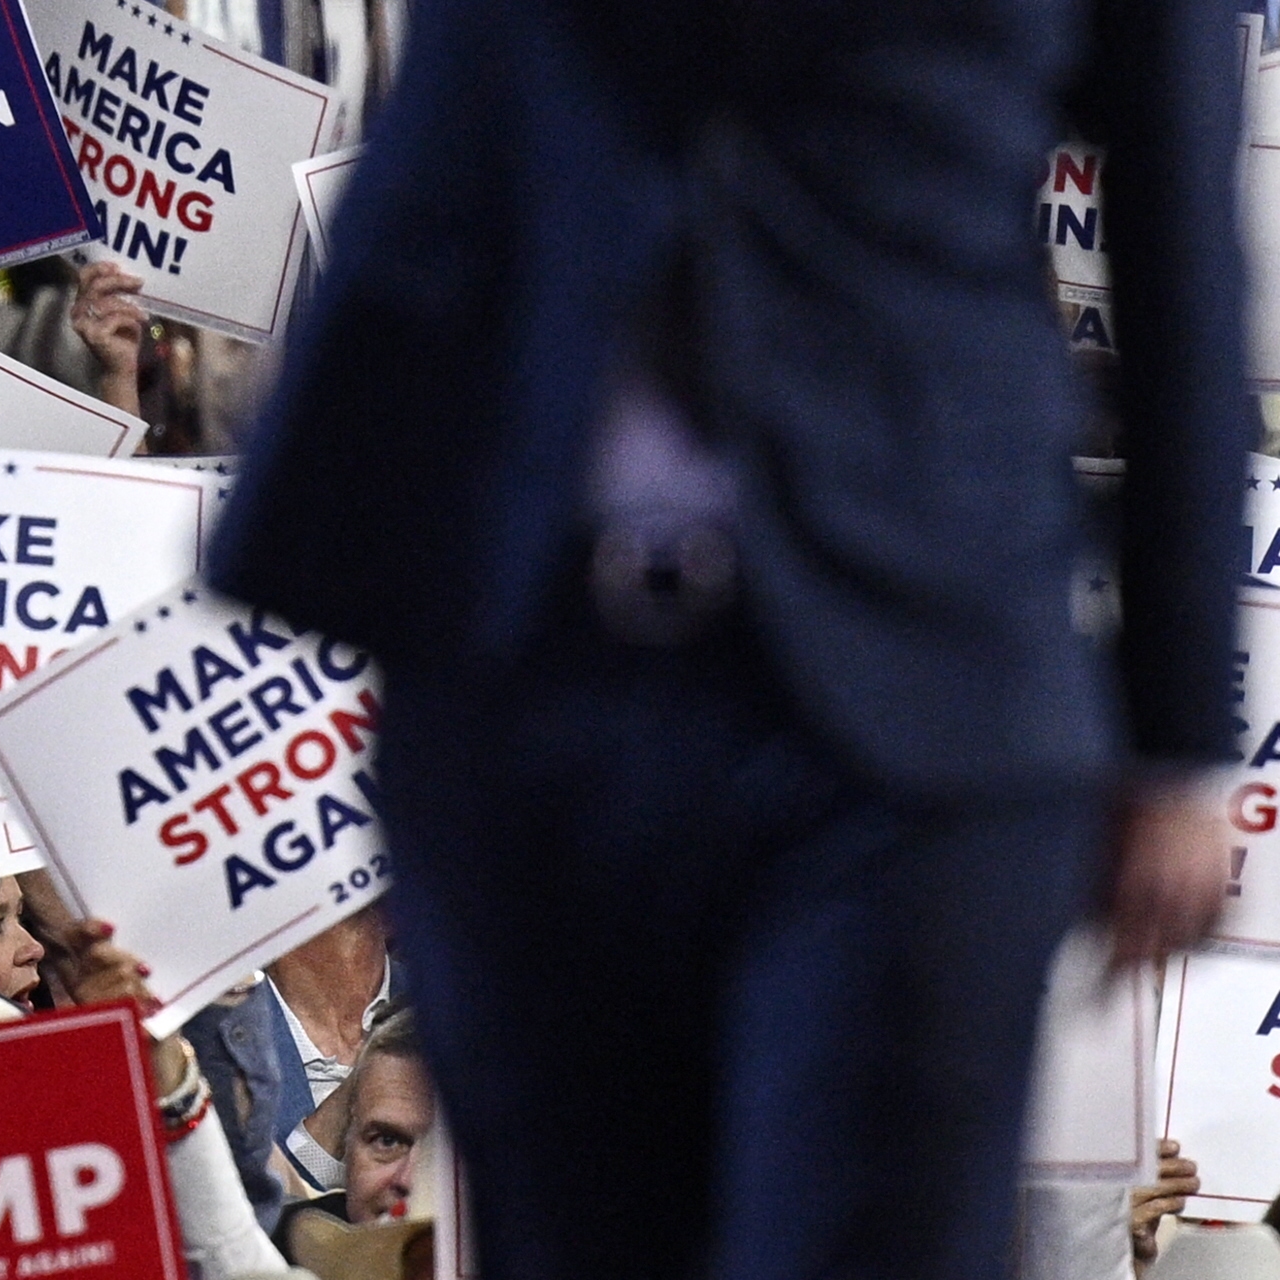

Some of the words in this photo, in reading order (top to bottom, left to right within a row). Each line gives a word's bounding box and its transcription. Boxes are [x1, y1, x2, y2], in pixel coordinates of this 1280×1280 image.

[45, 51, 236, 195] AMERICA
[78, 20, 210, 127] MAKE
[118, 634, 369, 826] AMERIC
[126, 611, 298, 733] MAK
[158, 689, 380, 867] STRON
[328, 853, 391, 904] 202
